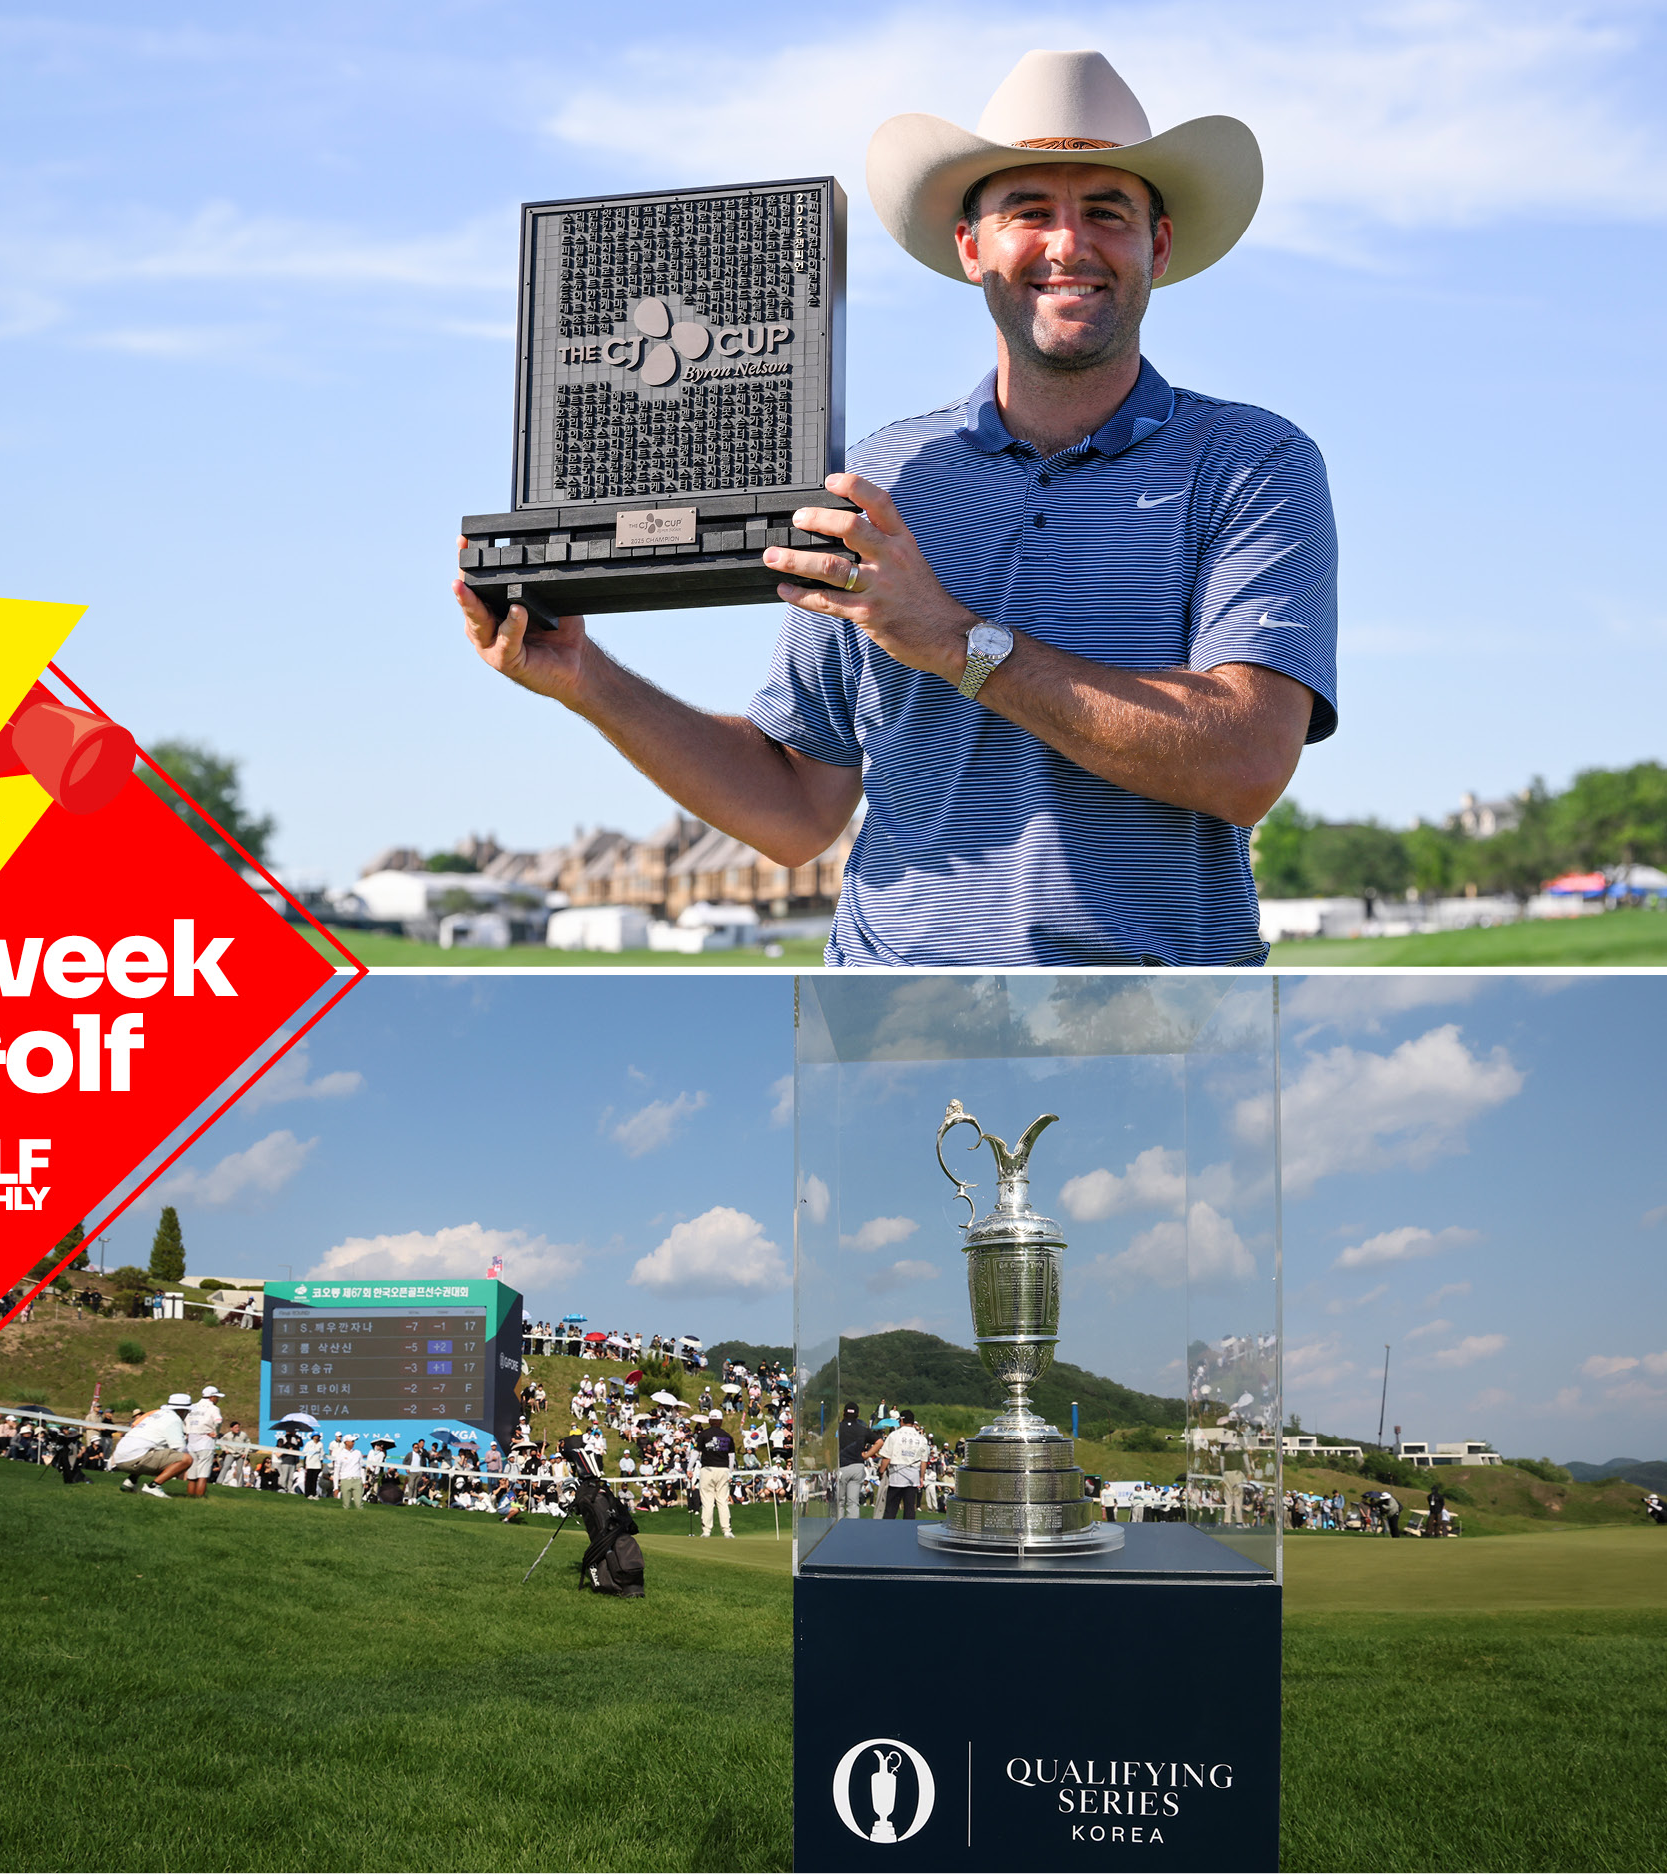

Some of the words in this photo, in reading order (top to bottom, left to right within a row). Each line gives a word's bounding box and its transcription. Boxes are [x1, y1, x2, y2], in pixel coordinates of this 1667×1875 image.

[558, 344, 596, 363] THE
[602, 335, 644, 369] CJ
[715, 325, 789, 357] CUP
[682, 365, 730, 383] Byron
[734, 360, 788, 377] Nelson
[638, 521, 649, 531] CJ
[664, 519, 682, 528] CUP
[645, 536, 680, 544] CHAMPION
[342, 1286, 373, 1299] 제67회
[373, 1285, 470, 1299] 한국오픈골프선수권대회
[405, 1321, 419, 1332] -7
[433, 1321, 446, 1332] -1
[464, 1321, 476, 1332] 17
[281, 1343, 288, 1354] 2
[405, 1342, 419, 1353] -5
[433, 1342, 447, 1352] +2
[464, 1342, 476, 1353] 17
[280, 1364, 288, 1374] 3
[404, 1362, 418, 1373] -3
[432, 1362, 446, 1373] +1
[463, 1362, 476, 1373] 17
[277, 1384, 291, 1395] T4
[298, 1383, 310, 1395] 코
[316, 1383, 352, 1396] 타이치
[404, 1383, 418, 1394] -2
[432, 1383, 446, 1393] -7
[465, 1383, 472, 1393] F
[403, 1404, 418, 1415] -2
[432, 1404, 446, 1414] -3
[464, 1404, 472, 1414] F
[1005, 1756, 1234, 1790] QUALIFYING
[1057, 1789, 1181, 1818] SERIES
[1071, 1825, 1165, 1844] KOREA
